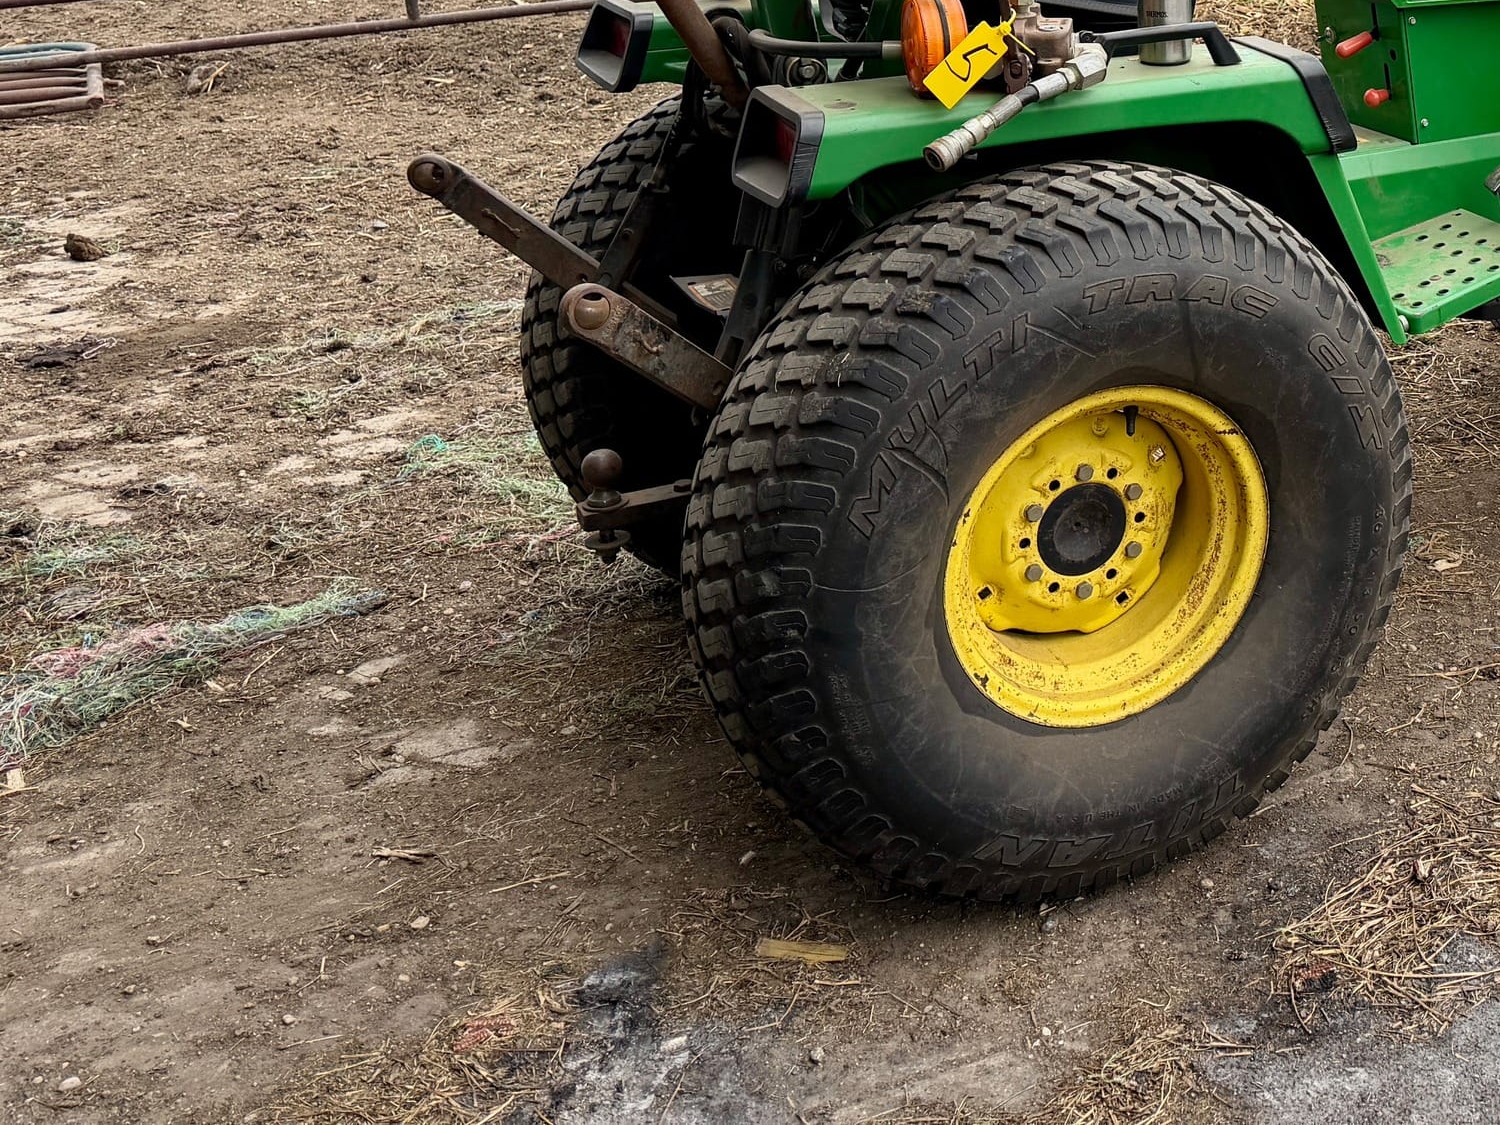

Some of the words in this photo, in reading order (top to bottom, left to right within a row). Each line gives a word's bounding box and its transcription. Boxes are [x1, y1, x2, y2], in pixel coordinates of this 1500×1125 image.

[848, 311, 1030, 539] MULTI
[1082, 272, 1279, 321] TRAC
[971, 767, 1245, 869] TITAN
